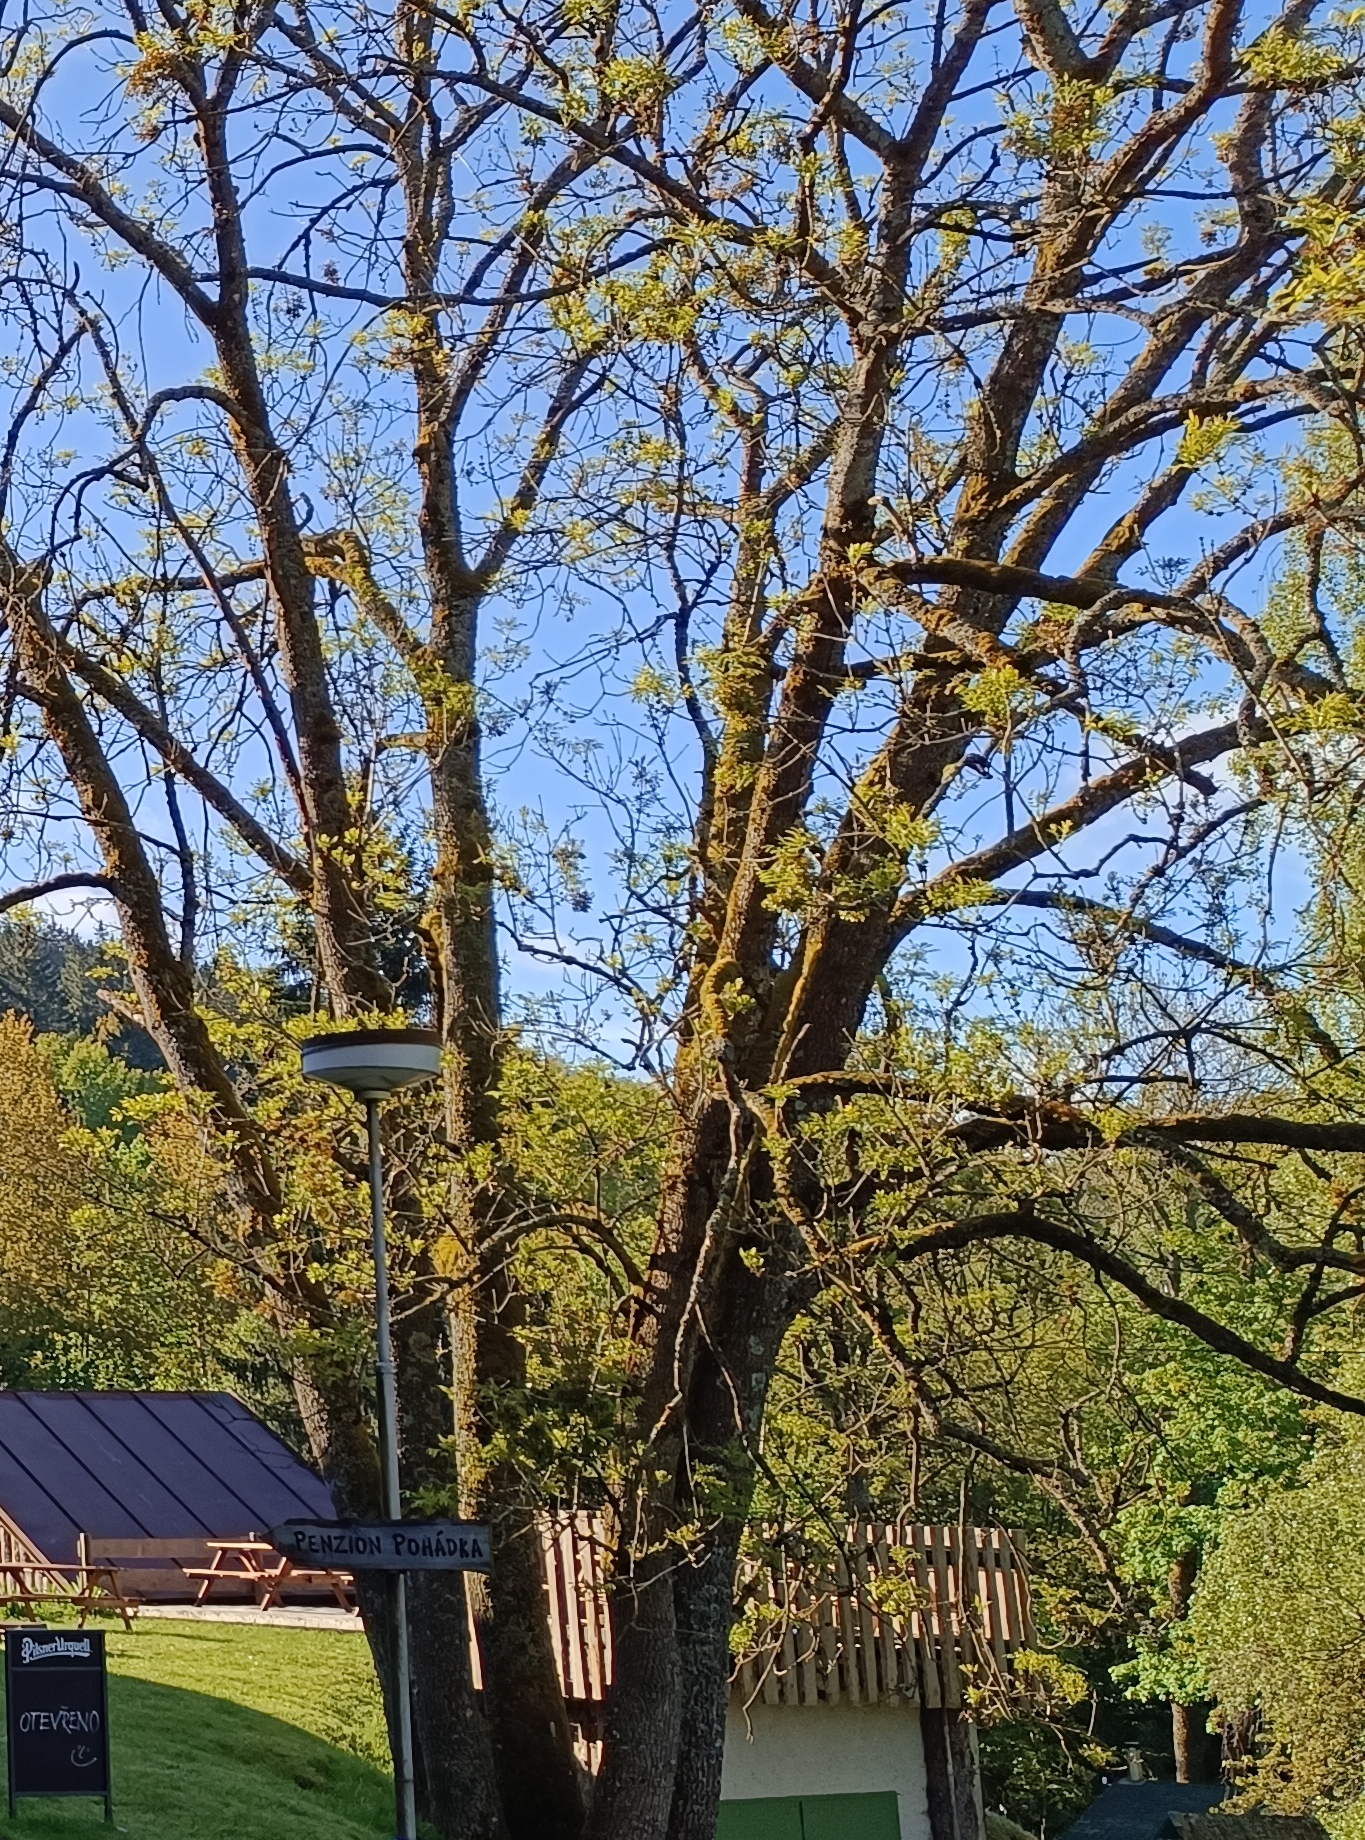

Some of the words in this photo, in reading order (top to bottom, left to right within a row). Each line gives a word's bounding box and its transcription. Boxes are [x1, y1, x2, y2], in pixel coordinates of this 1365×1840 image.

[293, 1531, 381, 1555] PENZION
[392, 1530, 483, 1558] POHÁDKA
[20, 1705, 100, 1735] OTEVŘENO
